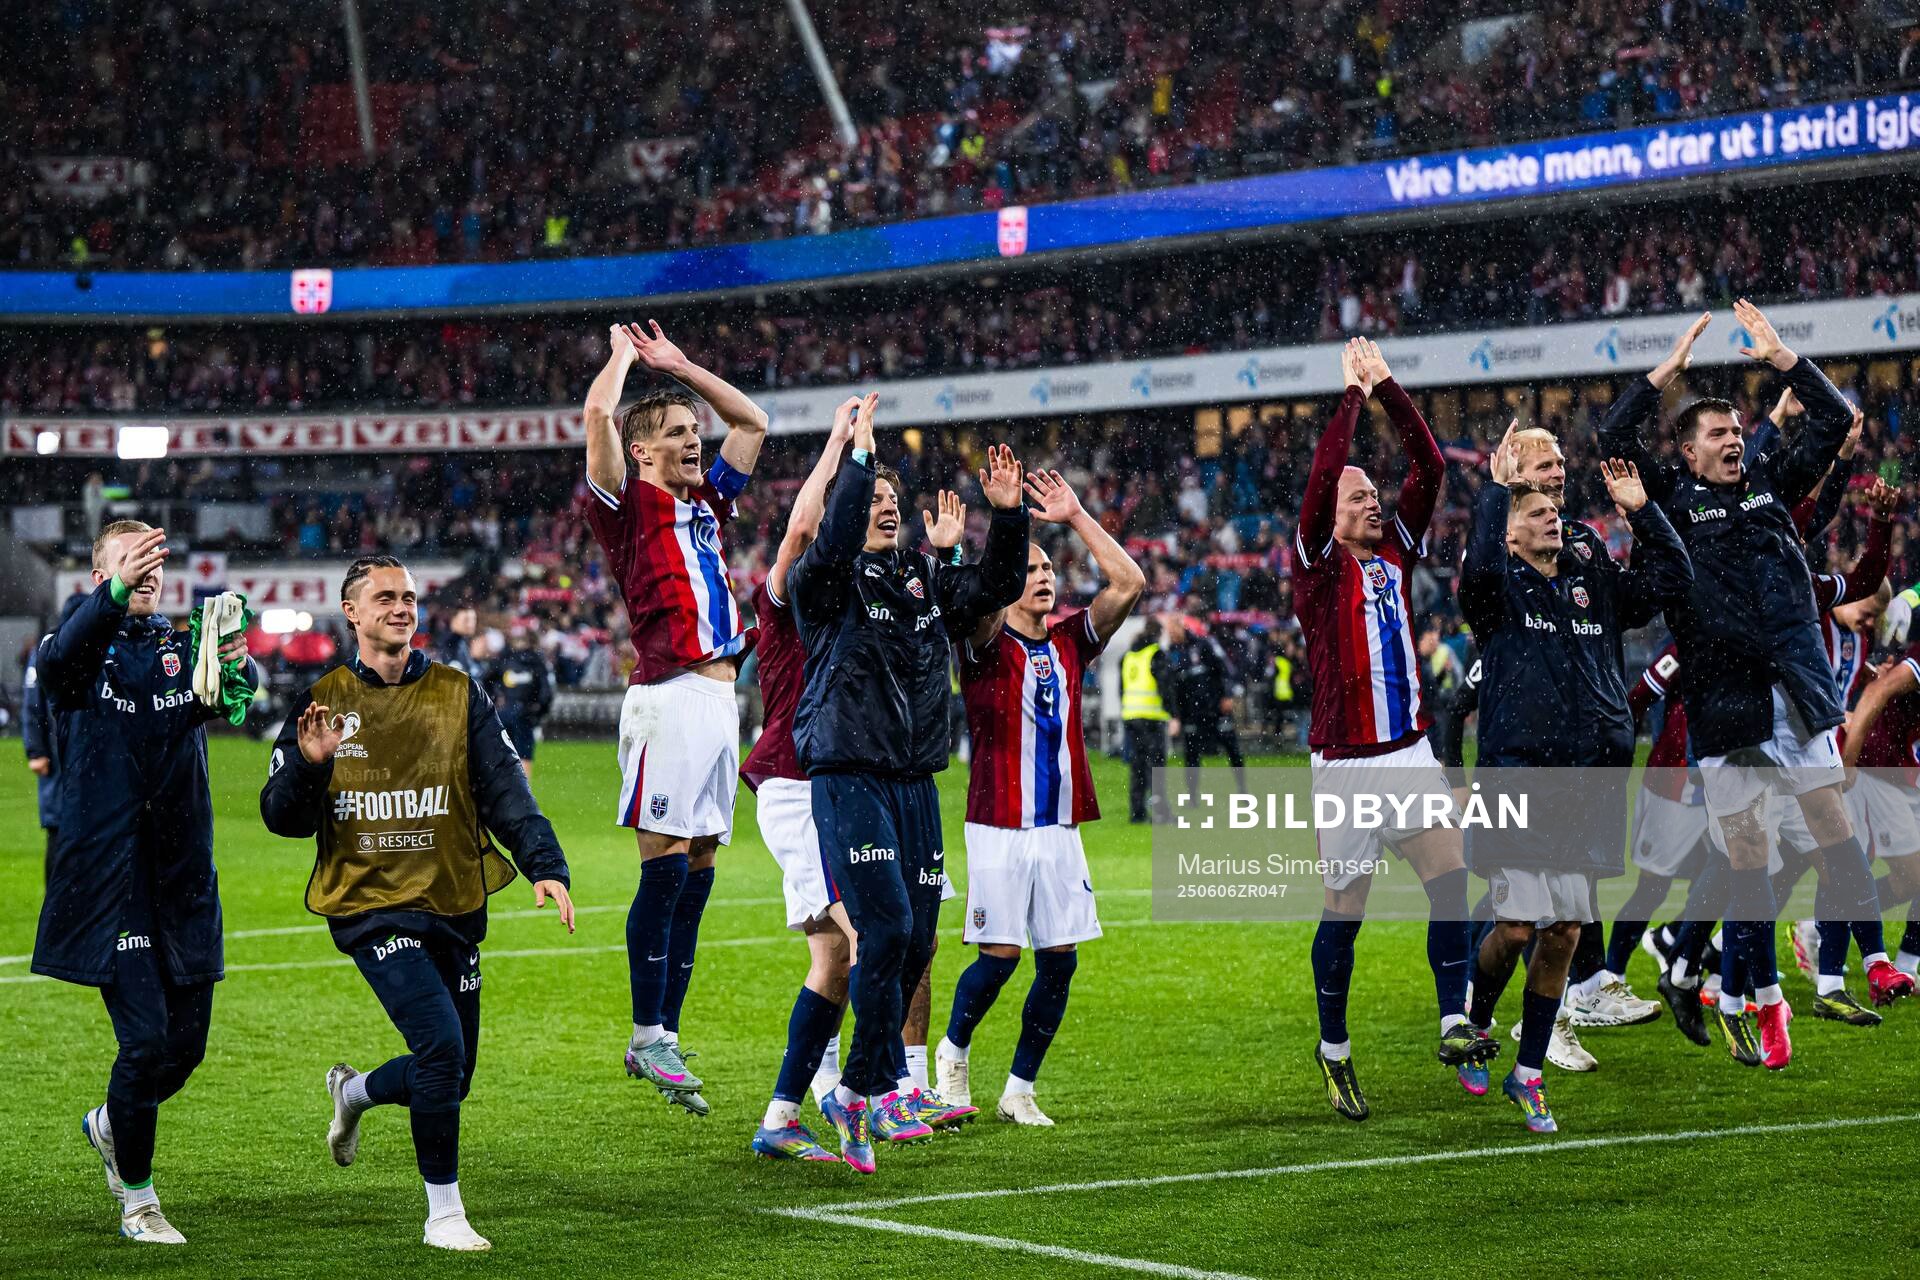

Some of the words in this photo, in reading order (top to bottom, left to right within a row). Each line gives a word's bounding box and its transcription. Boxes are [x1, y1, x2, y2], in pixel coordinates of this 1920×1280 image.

[1385, 157, 1453, 201] Våre
[1456, 154, 1540, 194] beste
[1543, 143, 1641, 184] menn,
[1646, 130, 1714, 170] drar
[1719, 121, 1757, 161] ut
[1762, 112, 1774, 155] i
[1779, 104, 1859, 153] strid
[1042, 687, 1055, 717] 4
[334, 785, 450, 821] #FOOTBALL
[378, 834, 433, 848] RESPECT
[850, 847, 895, 864] bama
[117, 936, 151, 951] ama
